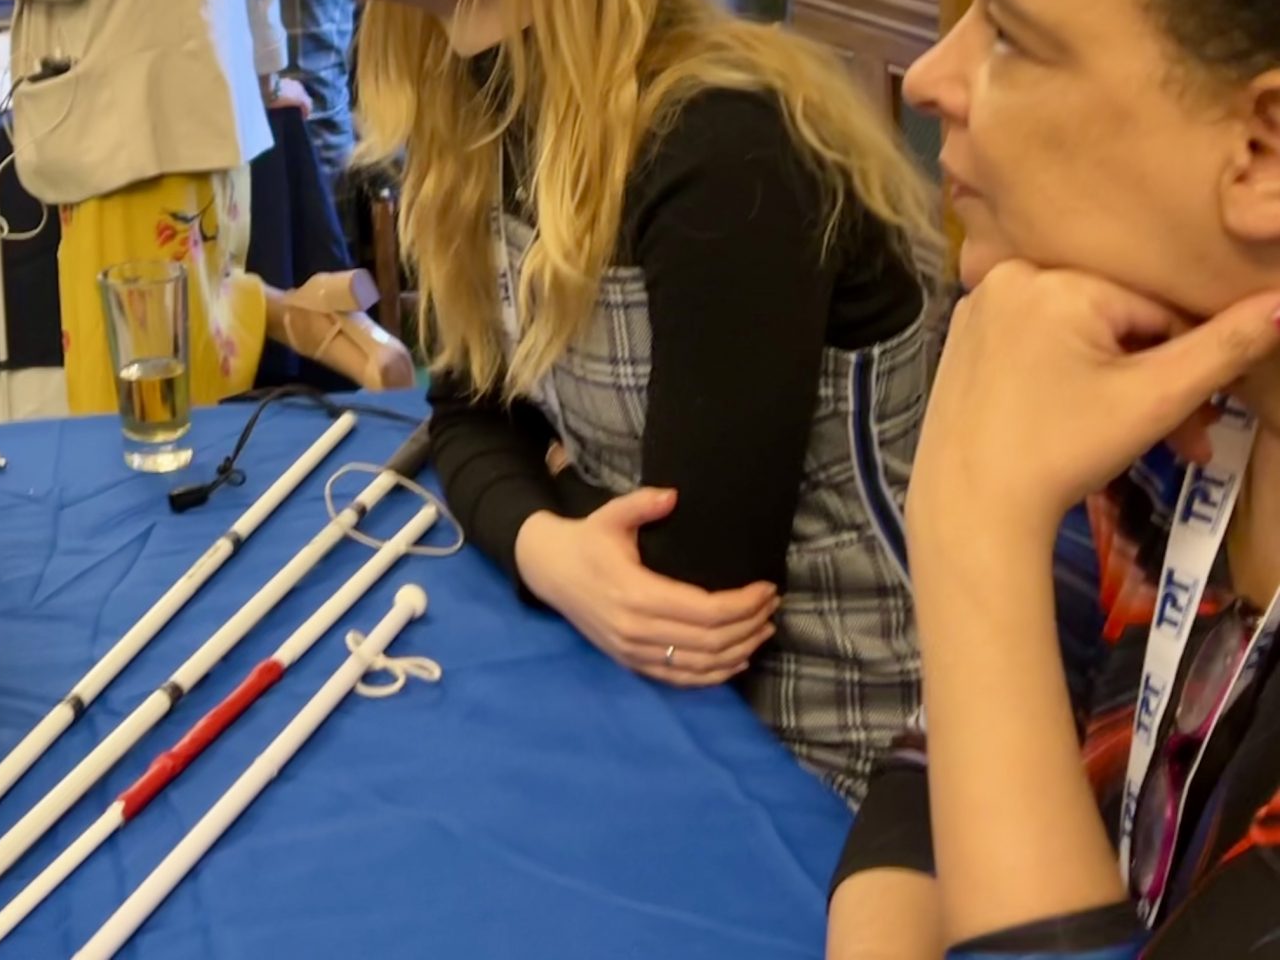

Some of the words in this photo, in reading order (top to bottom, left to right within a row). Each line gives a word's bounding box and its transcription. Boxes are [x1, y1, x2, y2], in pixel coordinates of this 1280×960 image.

[1180, 464, 1225, 525] TPT
[1156, 566, 1191, 628] TPT
[1136, 673, 1160, 733] TPT
